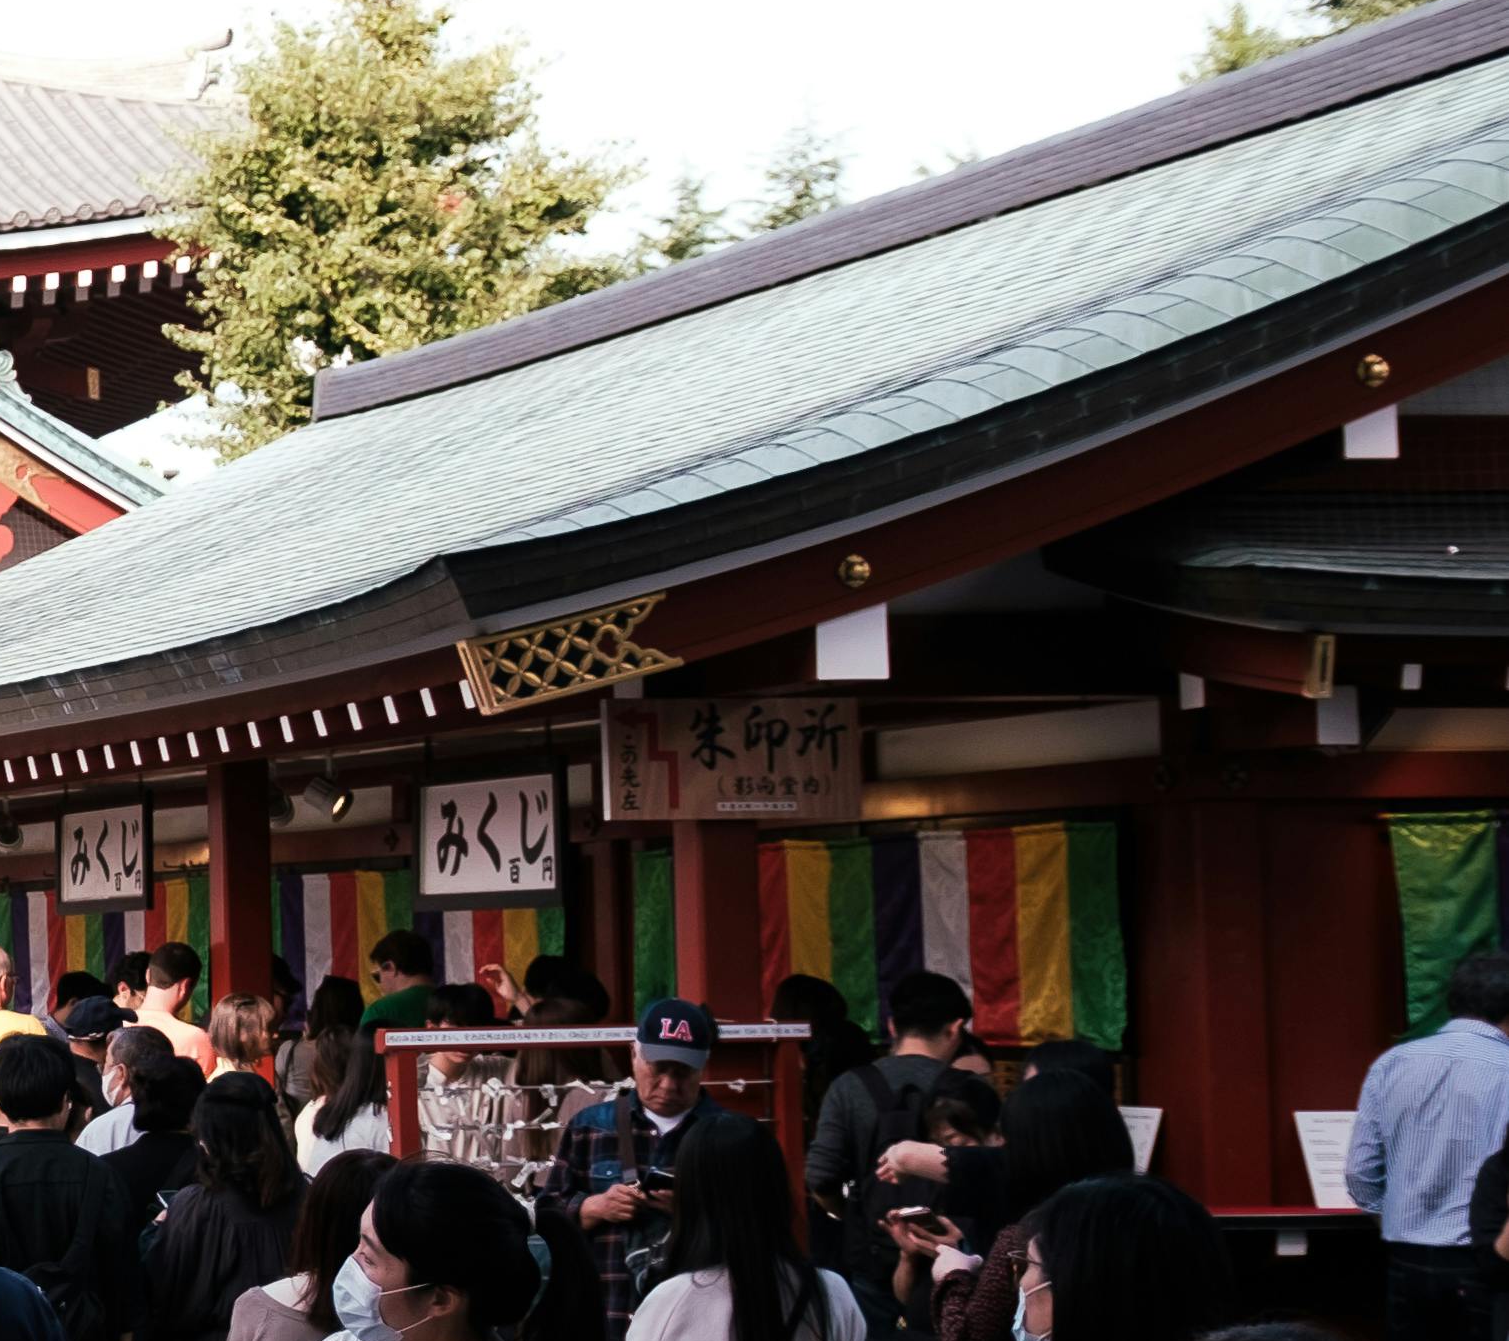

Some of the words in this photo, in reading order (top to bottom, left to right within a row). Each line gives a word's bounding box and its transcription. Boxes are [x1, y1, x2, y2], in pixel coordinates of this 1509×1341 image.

[689, 702, 848, 773] 朱印所
[619, 734, 641, 812] この先左
[70, 819, 139, 886] みくじ
[436, 790, 549, 877] みくじ
[508, 855, 553, 885] 百円
[659, 1017, 694, 1042] LA
